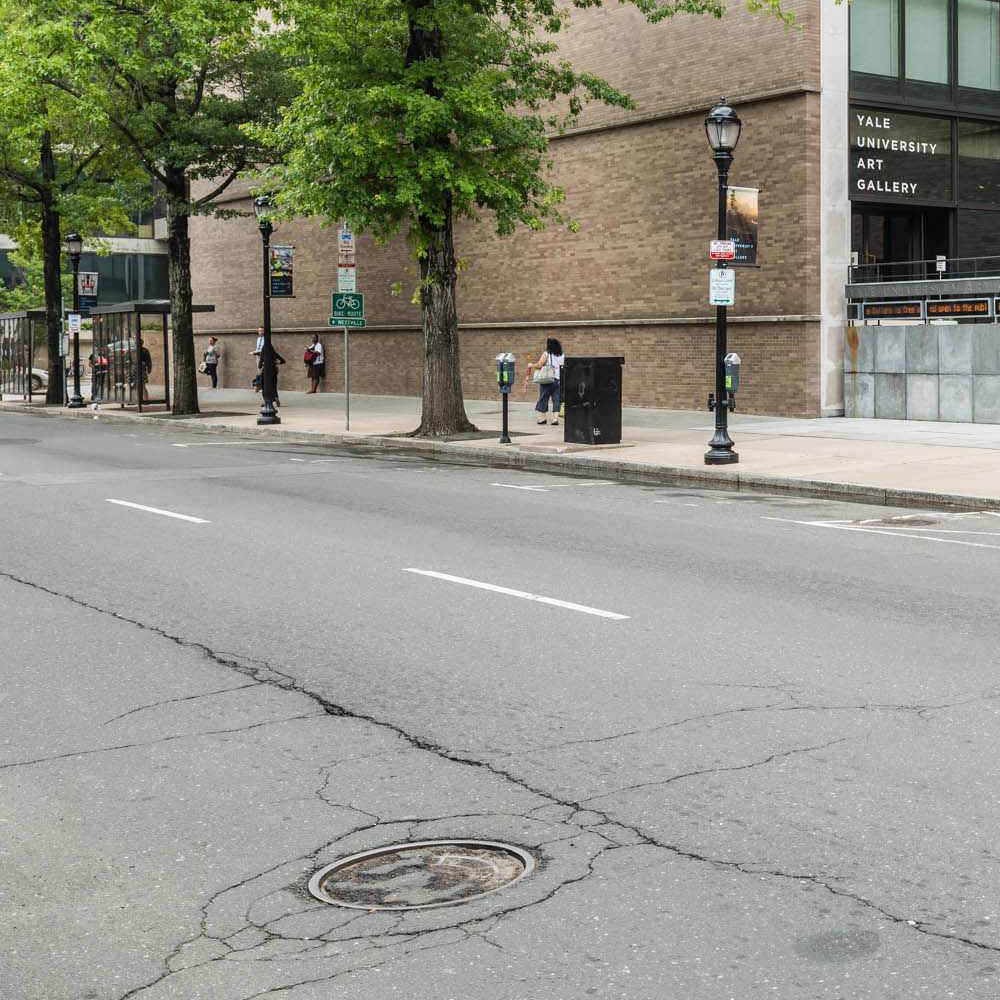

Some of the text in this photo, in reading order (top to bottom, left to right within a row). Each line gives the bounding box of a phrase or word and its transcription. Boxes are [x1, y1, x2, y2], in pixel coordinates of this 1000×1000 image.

[857, 114, 890, 129] YALE
[857, 136, 937, 154] UNIVERSITY
[857, 158, 883, 170] ART
[857, 179, 917, 194] GALLERY
[962, 303, 972, 312] the
